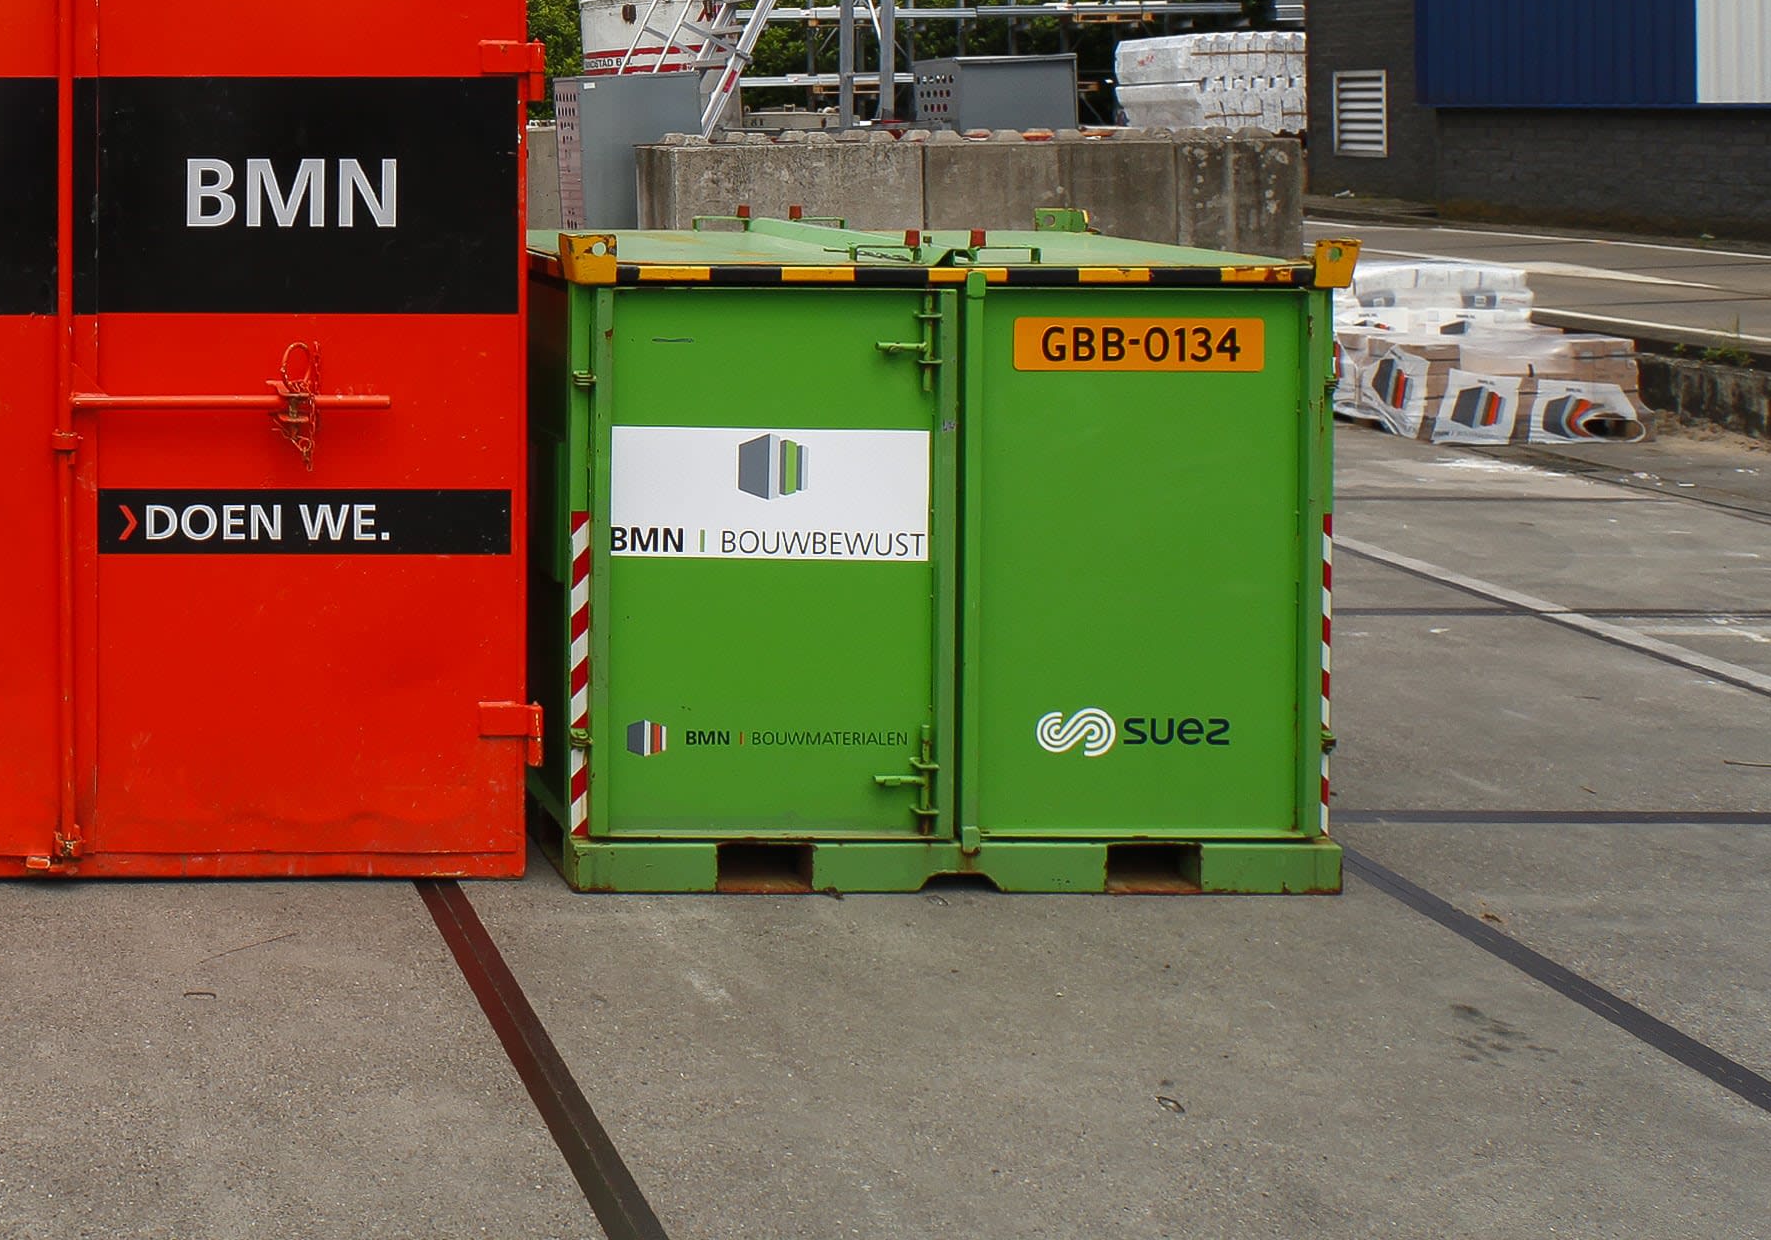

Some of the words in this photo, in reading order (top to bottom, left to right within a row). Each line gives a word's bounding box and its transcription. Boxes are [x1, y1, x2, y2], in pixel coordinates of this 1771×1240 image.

[186, 158, 398, 227] BMN
[1040, 326, 1242, 363] GBB-0134
[145, 504, 282, 540] DOEN
[298, 504, 390, 540] WE.
[609, 527, 684, 554] BMN
[720, 529, 926, 557] BOUWBEWUST
[685, 730, 730, 746] BMN
[751, 731, 908, 748] BOUWMATERIALEN
